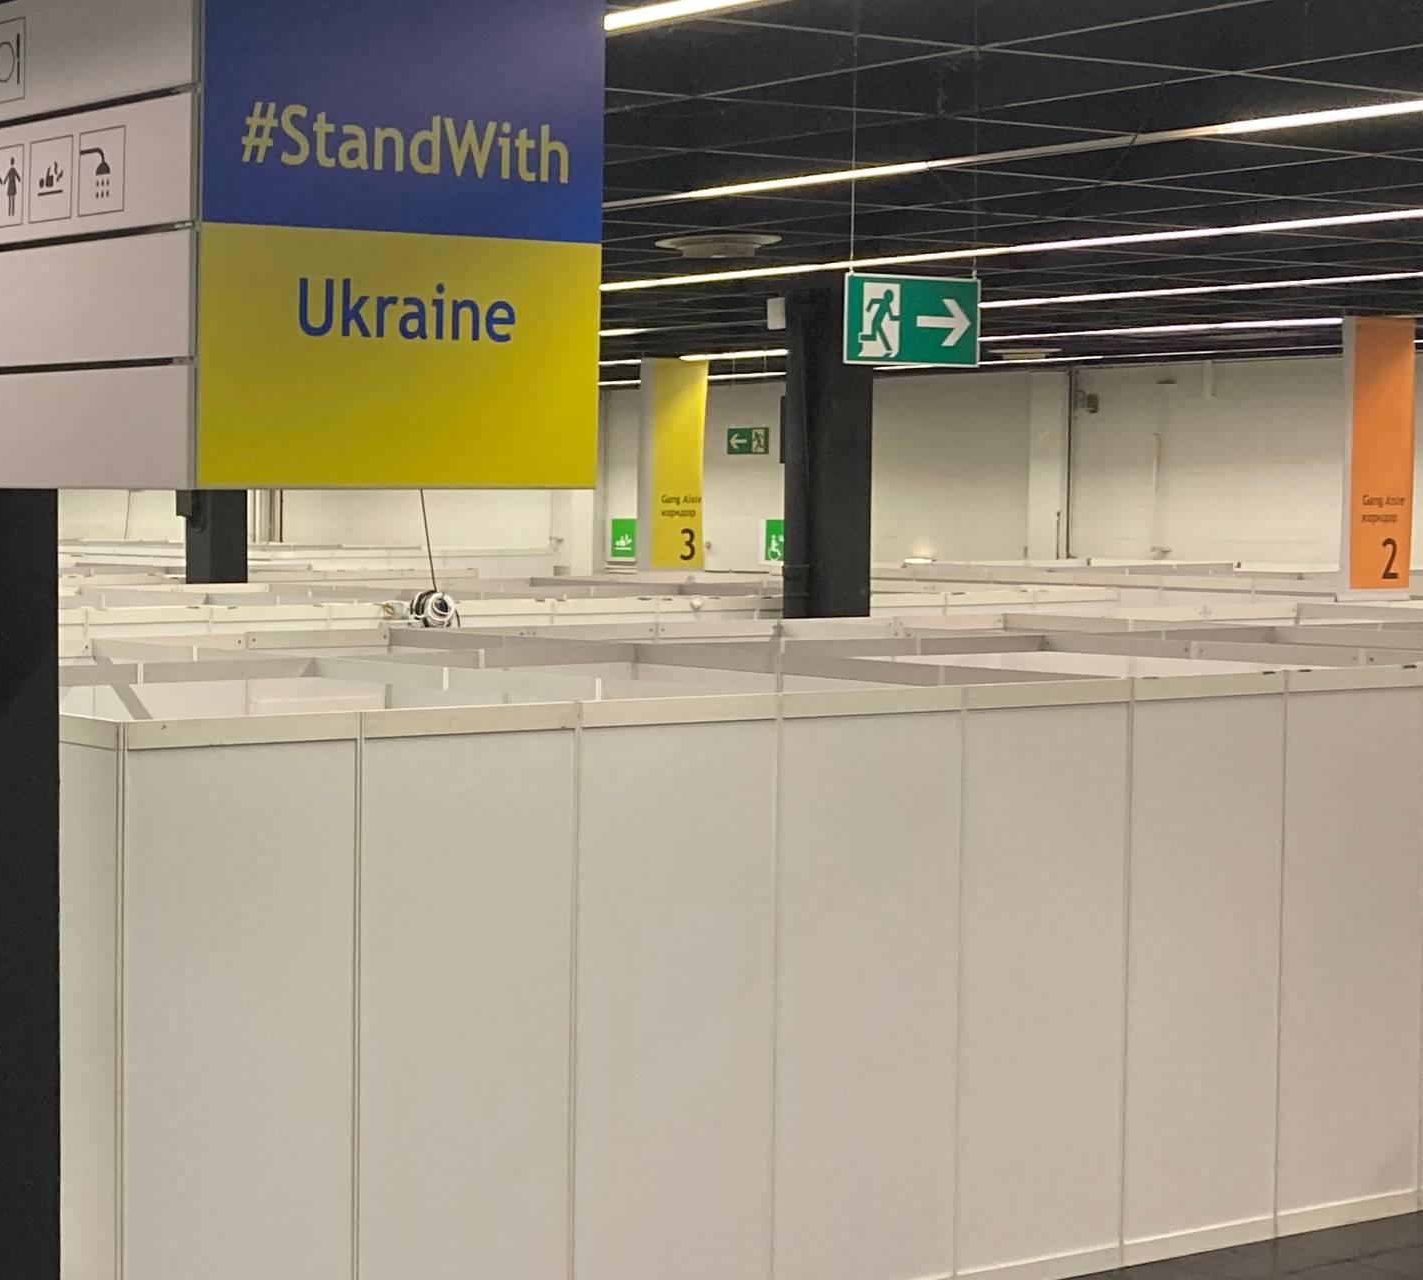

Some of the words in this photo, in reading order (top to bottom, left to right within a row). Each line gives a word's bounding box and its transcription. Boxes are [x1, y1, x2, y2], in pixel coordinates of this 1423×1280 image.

[241, 101, 569, 184] #StandWith
[298, 277, 516, 343] Ukraine
[680, 528, 695, 560] 3
[1381, 538, 1399, 579] 2
